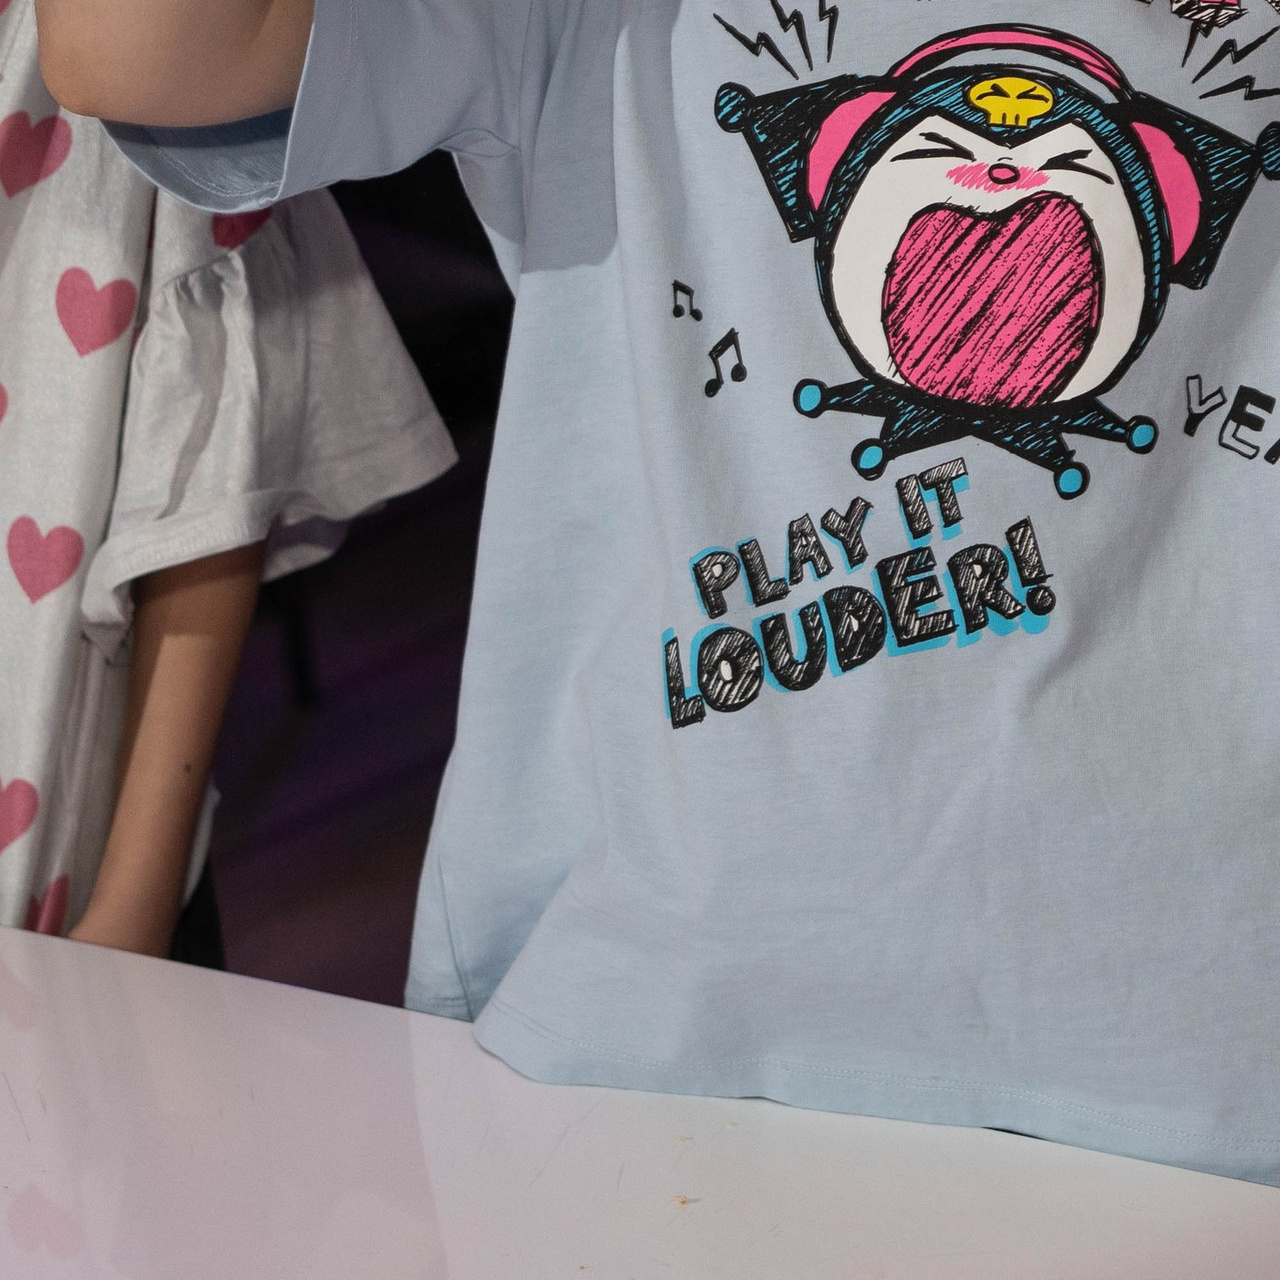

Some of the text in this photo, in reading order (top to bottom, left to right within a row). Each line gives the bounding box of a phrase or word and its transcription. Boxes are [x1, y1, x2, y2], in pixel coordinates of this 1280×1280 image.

[664, 516, 1057, 730] LOUDER!
[692, 457, 969, 619] PLAY IT
